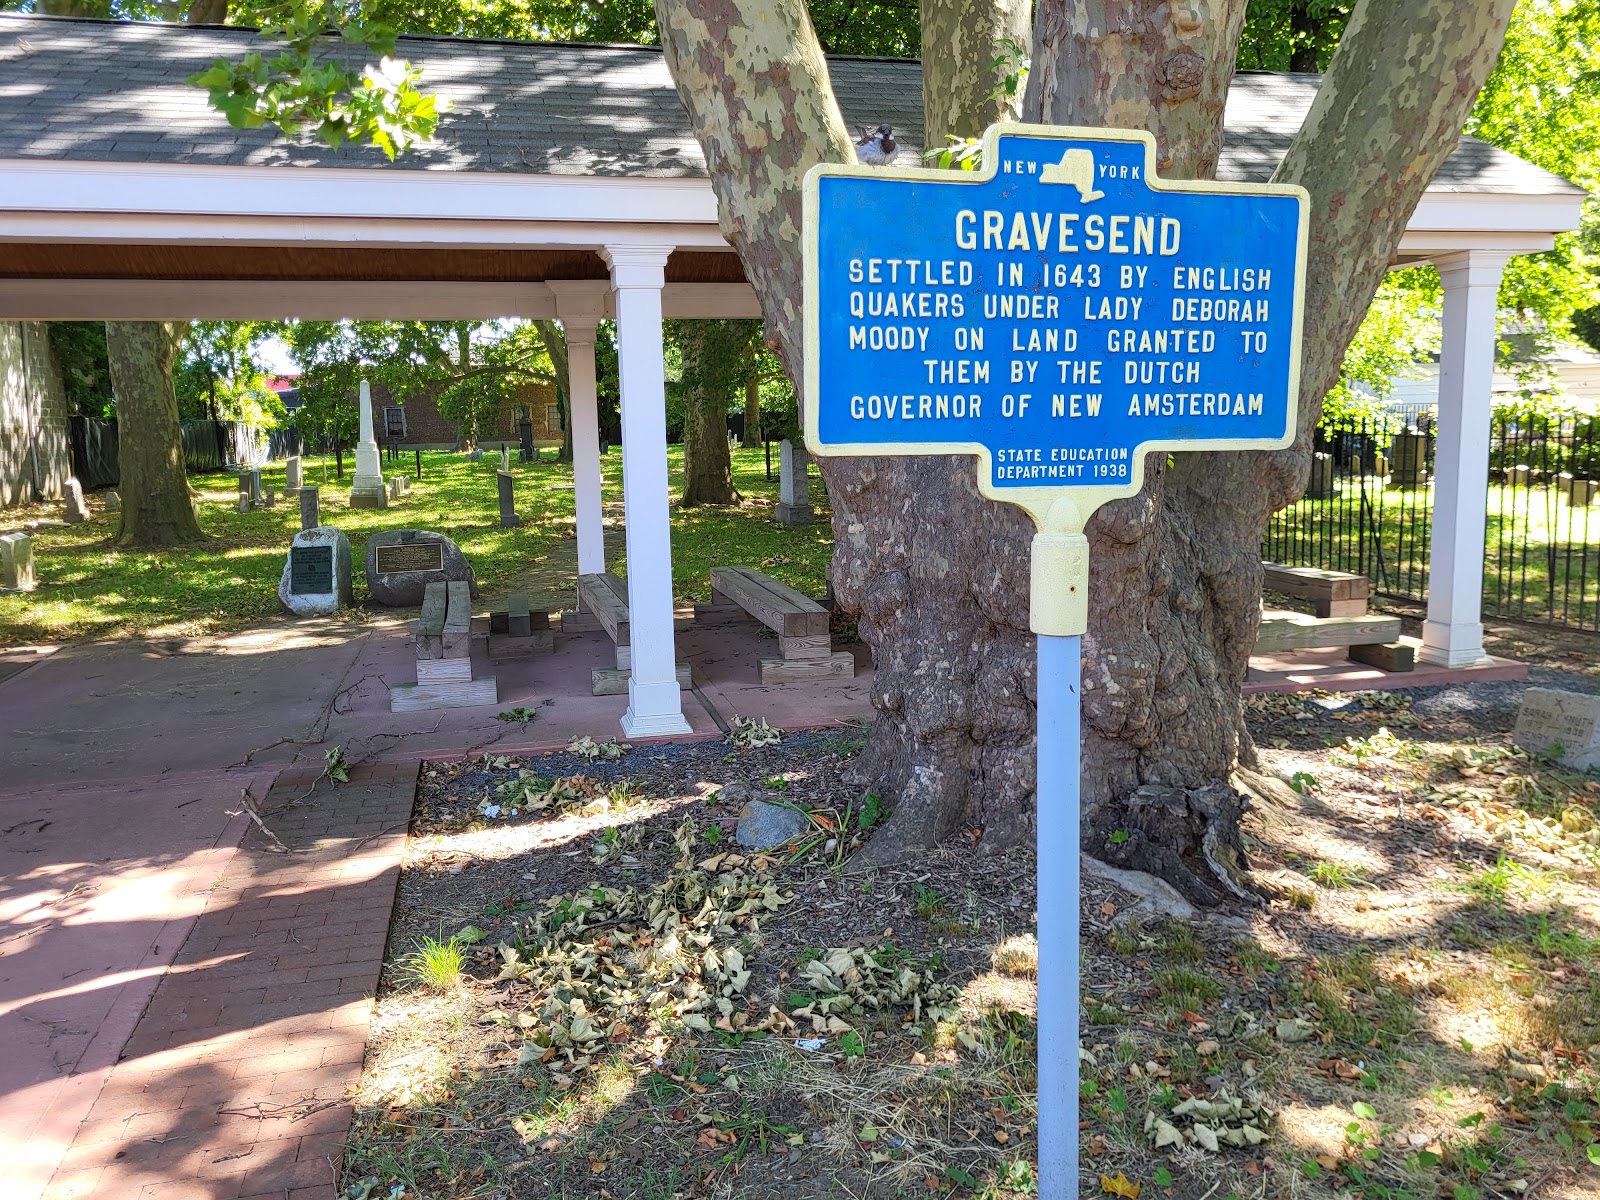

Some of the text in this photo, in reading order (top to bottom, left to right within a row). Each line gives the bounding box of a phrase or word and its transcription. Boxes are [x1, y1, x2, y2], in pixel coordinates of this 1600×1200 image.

[1003, 159, 1140, 180] NEW YORK
[955, 209, 1181, 256] GRAVESEND
[848, 258, 1271, 292] SETTLED IN 1643 BY ENGLISH
[850, 291, 1269, 323] QUAKERS UNDER LADY DEBORAH
[849, 325, 1267, 354] MOODY ON LAND GRANTED TO
[923, 359, 1200, 385] THEM BY THE DUTCH
[850, 392, 1264, 420] GOVERNOR OF NEW AMSTERDAM
[997, 447, 1128, 463] STATE EDUCATION
[997, 463, 1127, 480] DEPARTMENT 1938
